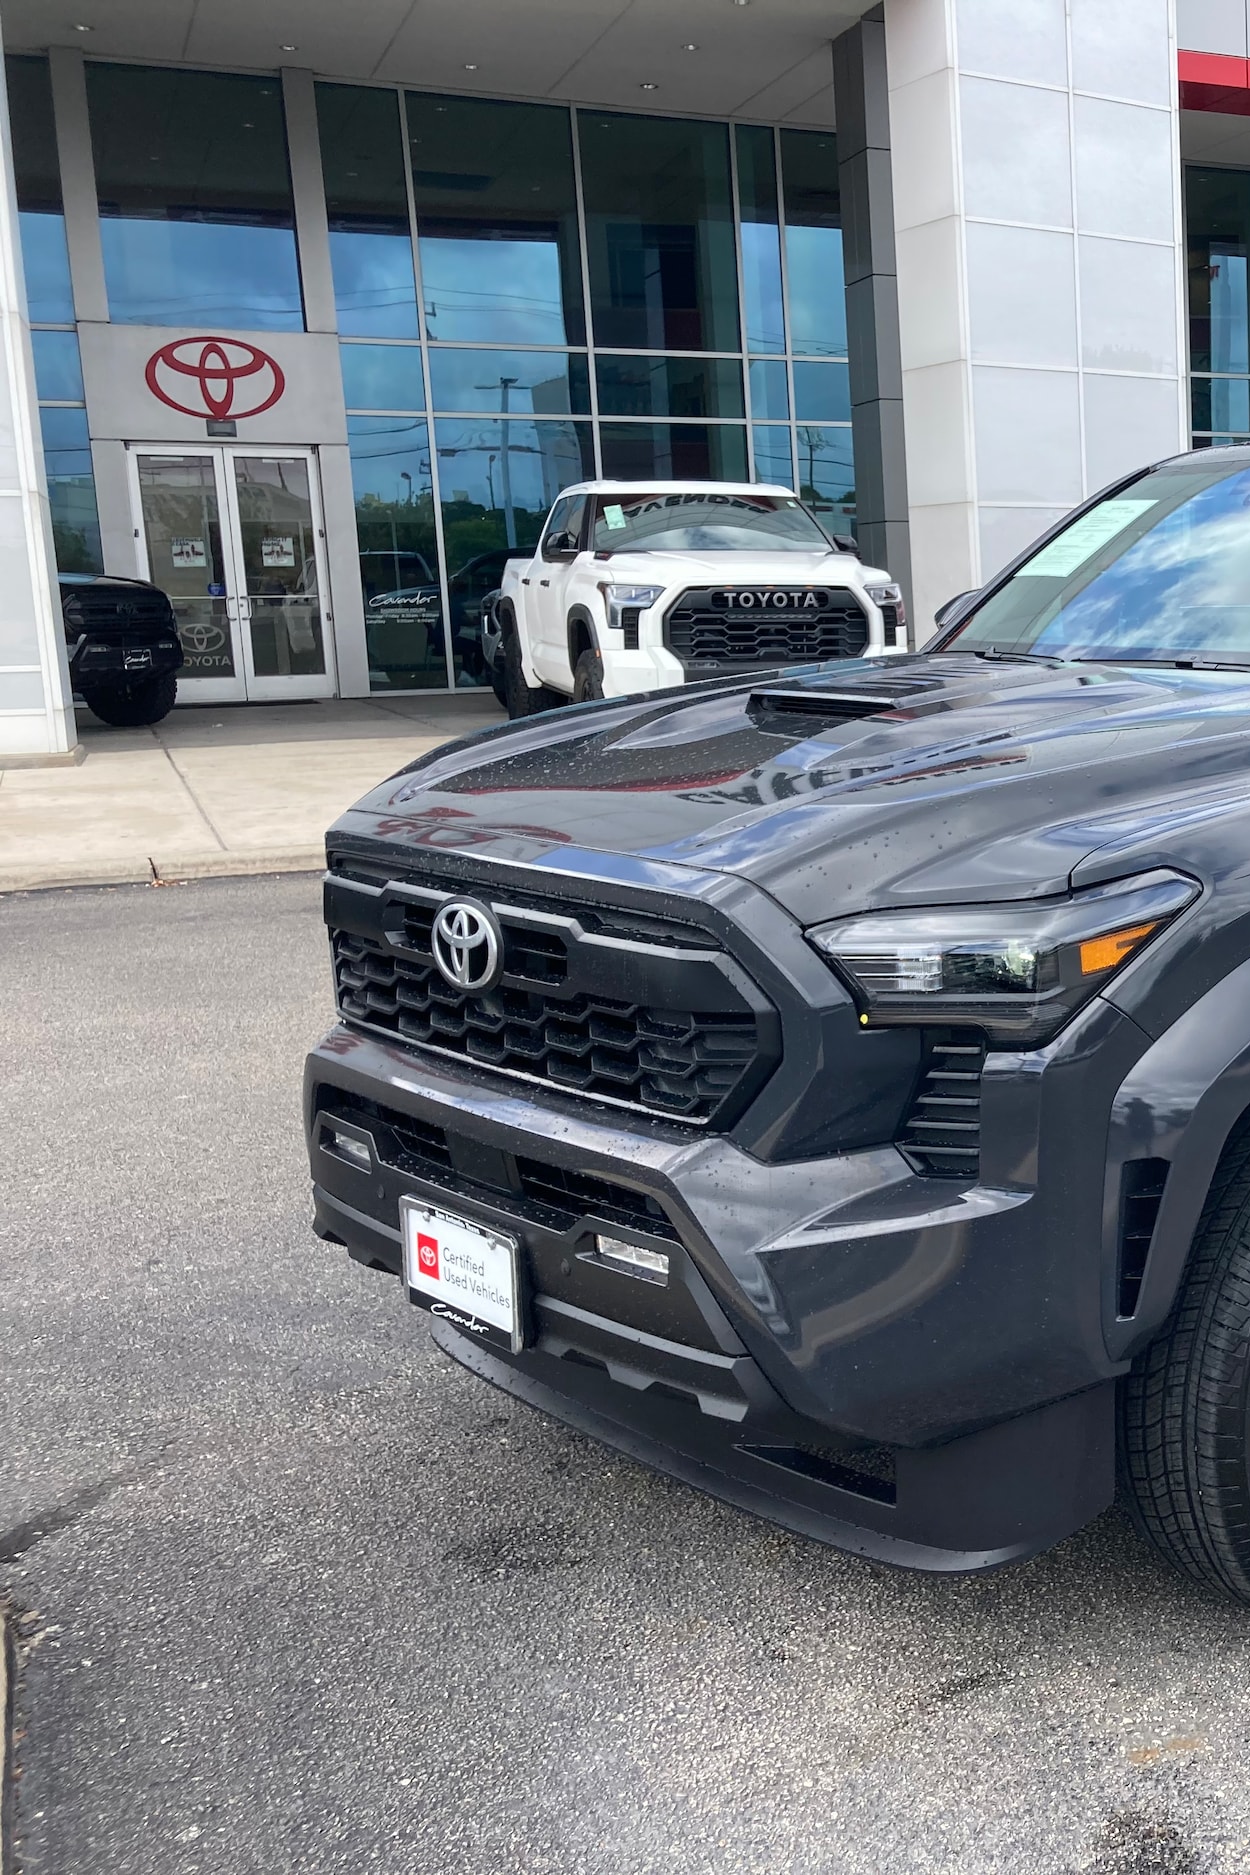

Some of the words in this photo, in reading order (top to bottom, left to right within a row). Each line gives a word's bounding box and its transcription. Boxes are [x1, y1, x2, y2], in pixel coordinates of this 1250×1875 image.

[369, 591, 437, 607] Cavender
[723, 592, 819, 608] TOYOTA
[183, 655, 232, 666] OYOTA
[443, 1247, 485, 1277] Certified
[443, 1266, 468, 1290] Used
[469, 1278, 511, 1309] Vehicles
[430, 1303, 490, 1333] Cavender
